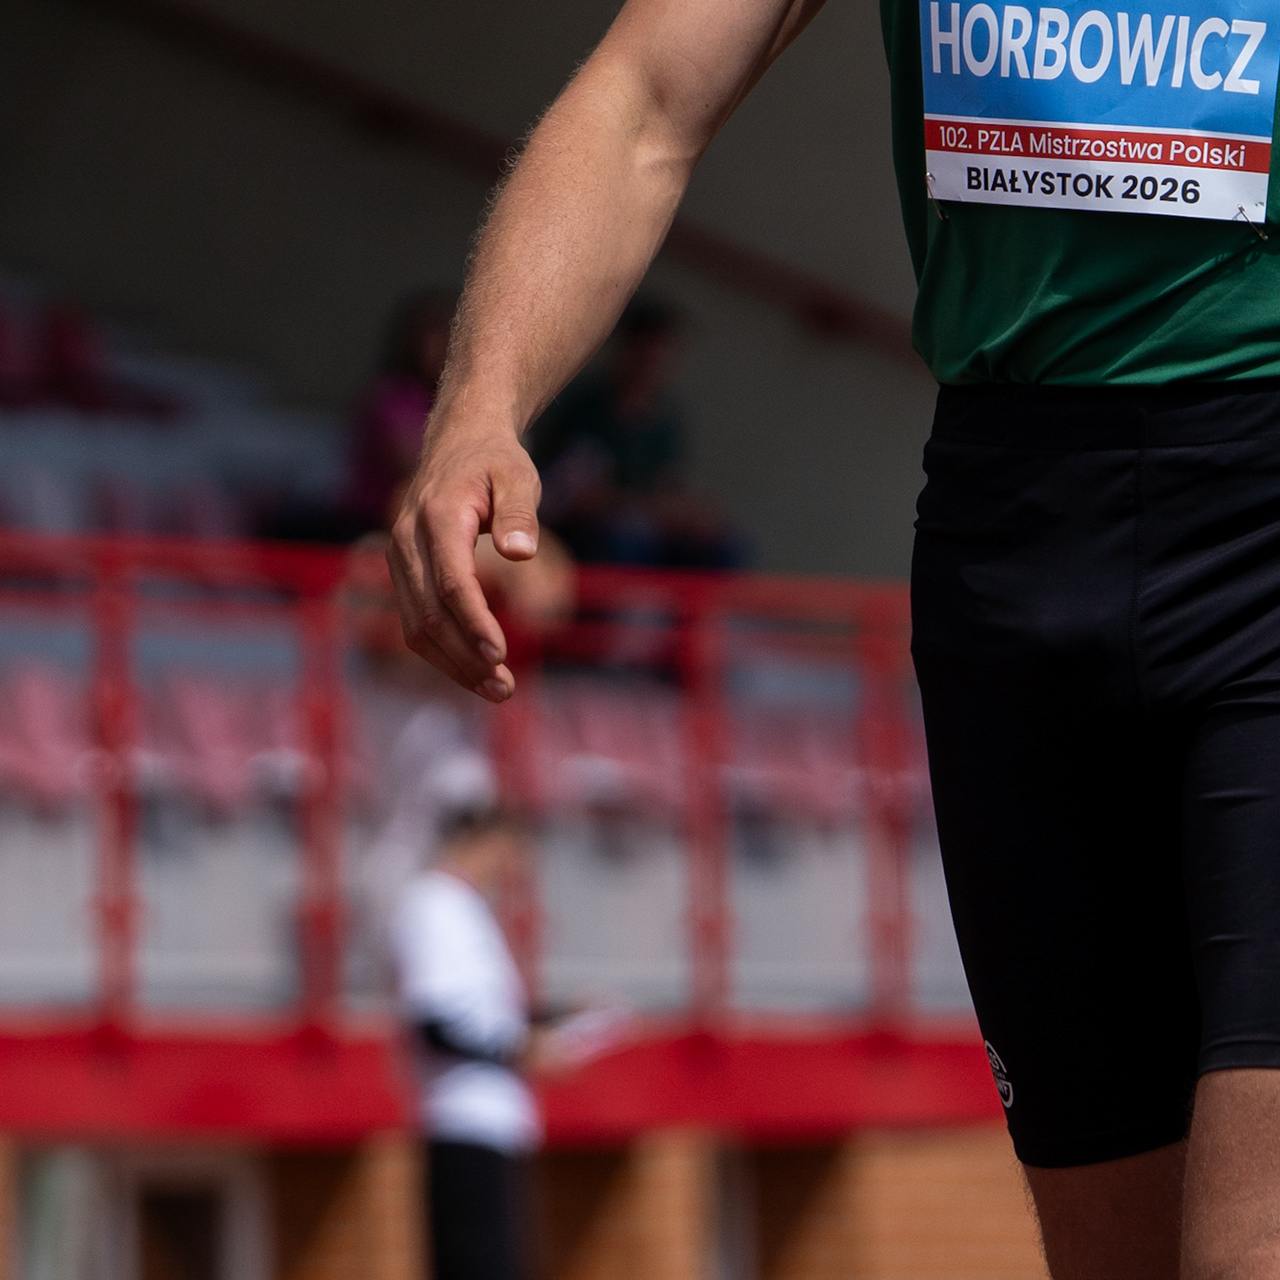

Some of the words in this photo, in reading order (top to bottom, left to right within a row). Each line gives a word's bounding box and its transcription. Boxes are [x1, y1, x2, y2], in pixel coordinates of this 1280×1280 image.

[930, 1, 1268, 95] HORBOWICZ
[939, 126, 972, 149] 102.
[978, 129, 1024, 152] PZLA
[1029, 132, 1163, 160] Mistrzostwa
[1169, 140, 1246, 167] Polski
[966, 166, 1115, 199] BIAŁYSTOK
[1121, 175, 1201, 204] 2026
